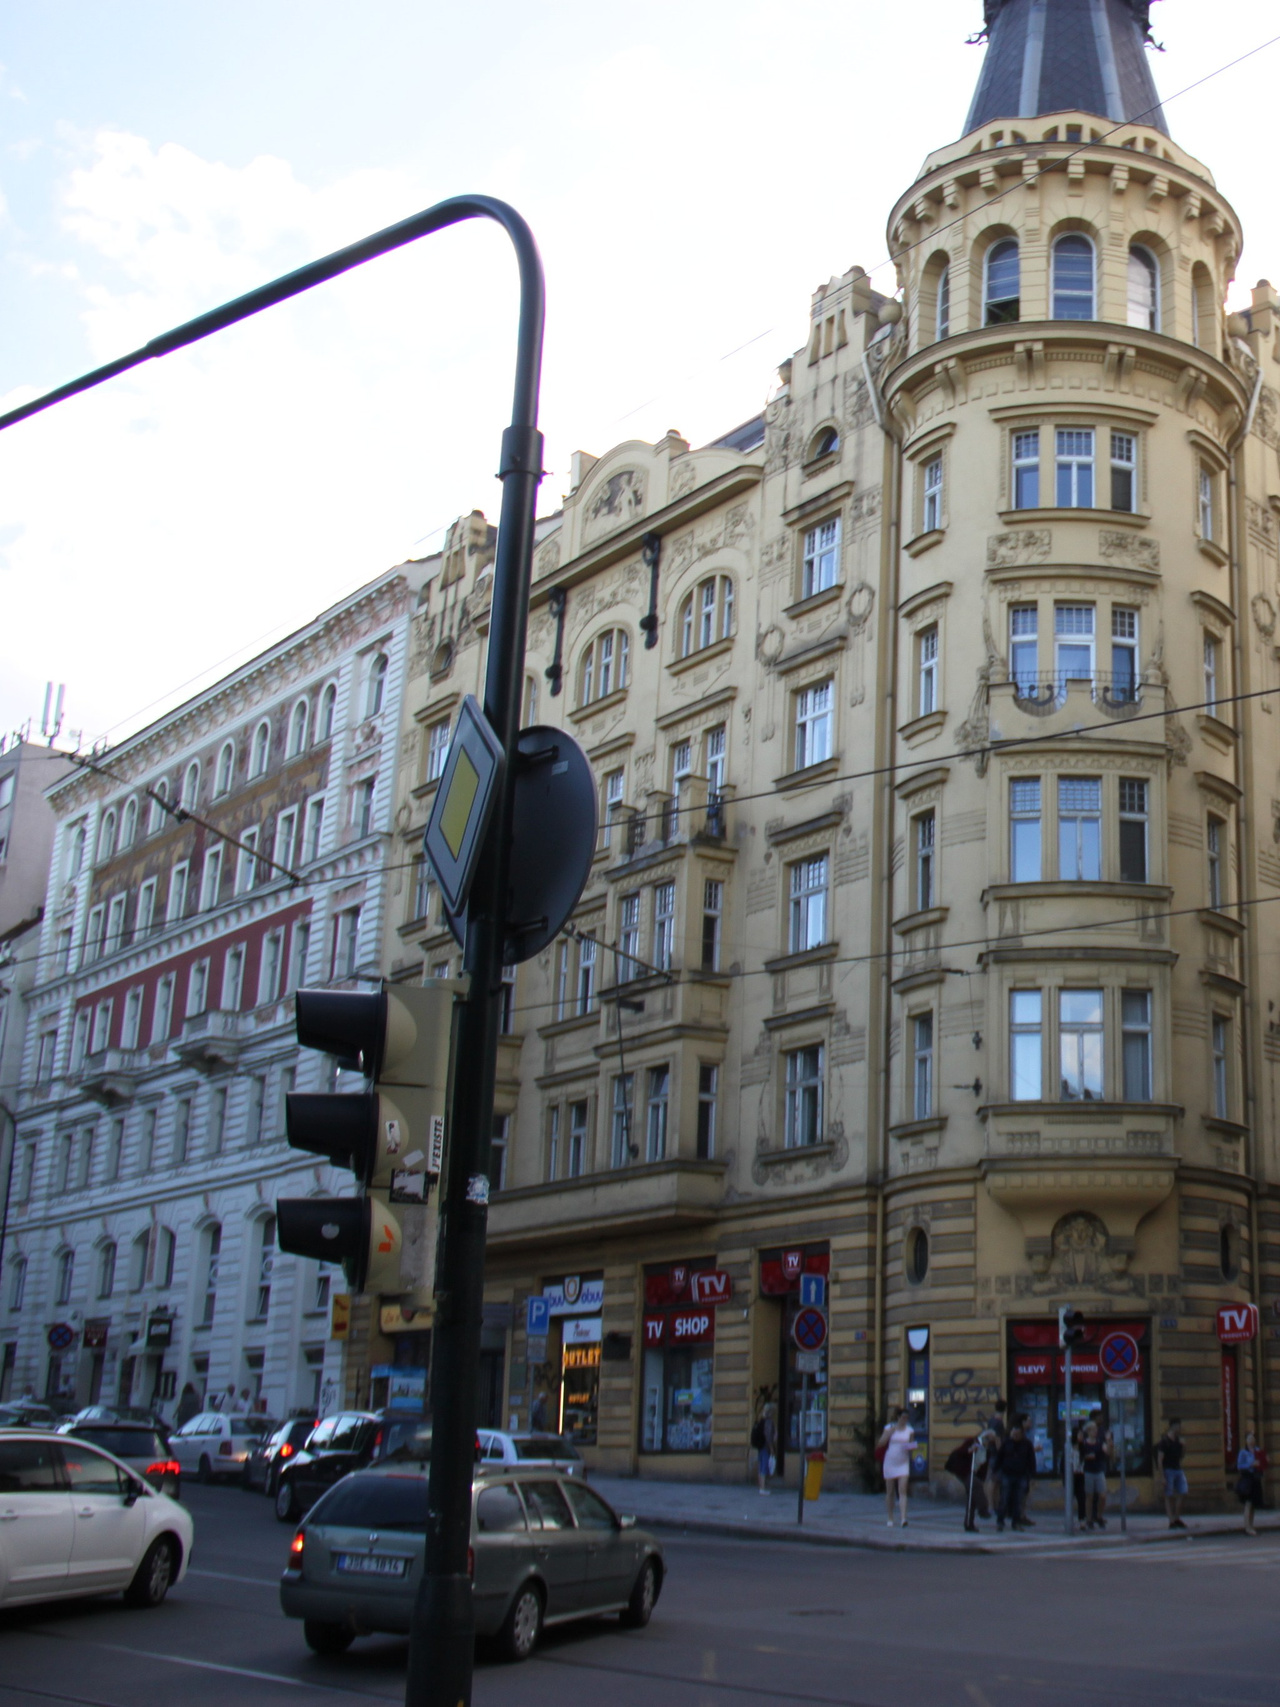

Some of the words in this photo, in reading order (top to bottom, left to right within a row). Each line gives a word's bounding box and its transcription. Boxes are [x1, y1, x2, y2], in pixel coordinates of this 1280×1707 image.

[432, 1117, 443, 1170] J'EXISTE.
[787, 1255, 799, 1267] TV
[675, 1267, 685, 1280] TV
[699, 1274, 727, 1295] TV
[532, 1301, 545, 1324] P
[1219, 1308, 1248, 1331] TV
[647, 1320, 664, 1340] TV
[674, 1316, 709, 1337] SHOP
[564, 1347, 601, 1367] OUTLET
[1018, 1364, 1046, 1374] SLEVY
[1060, 1363, 1099, 1374] VPRODEJ
